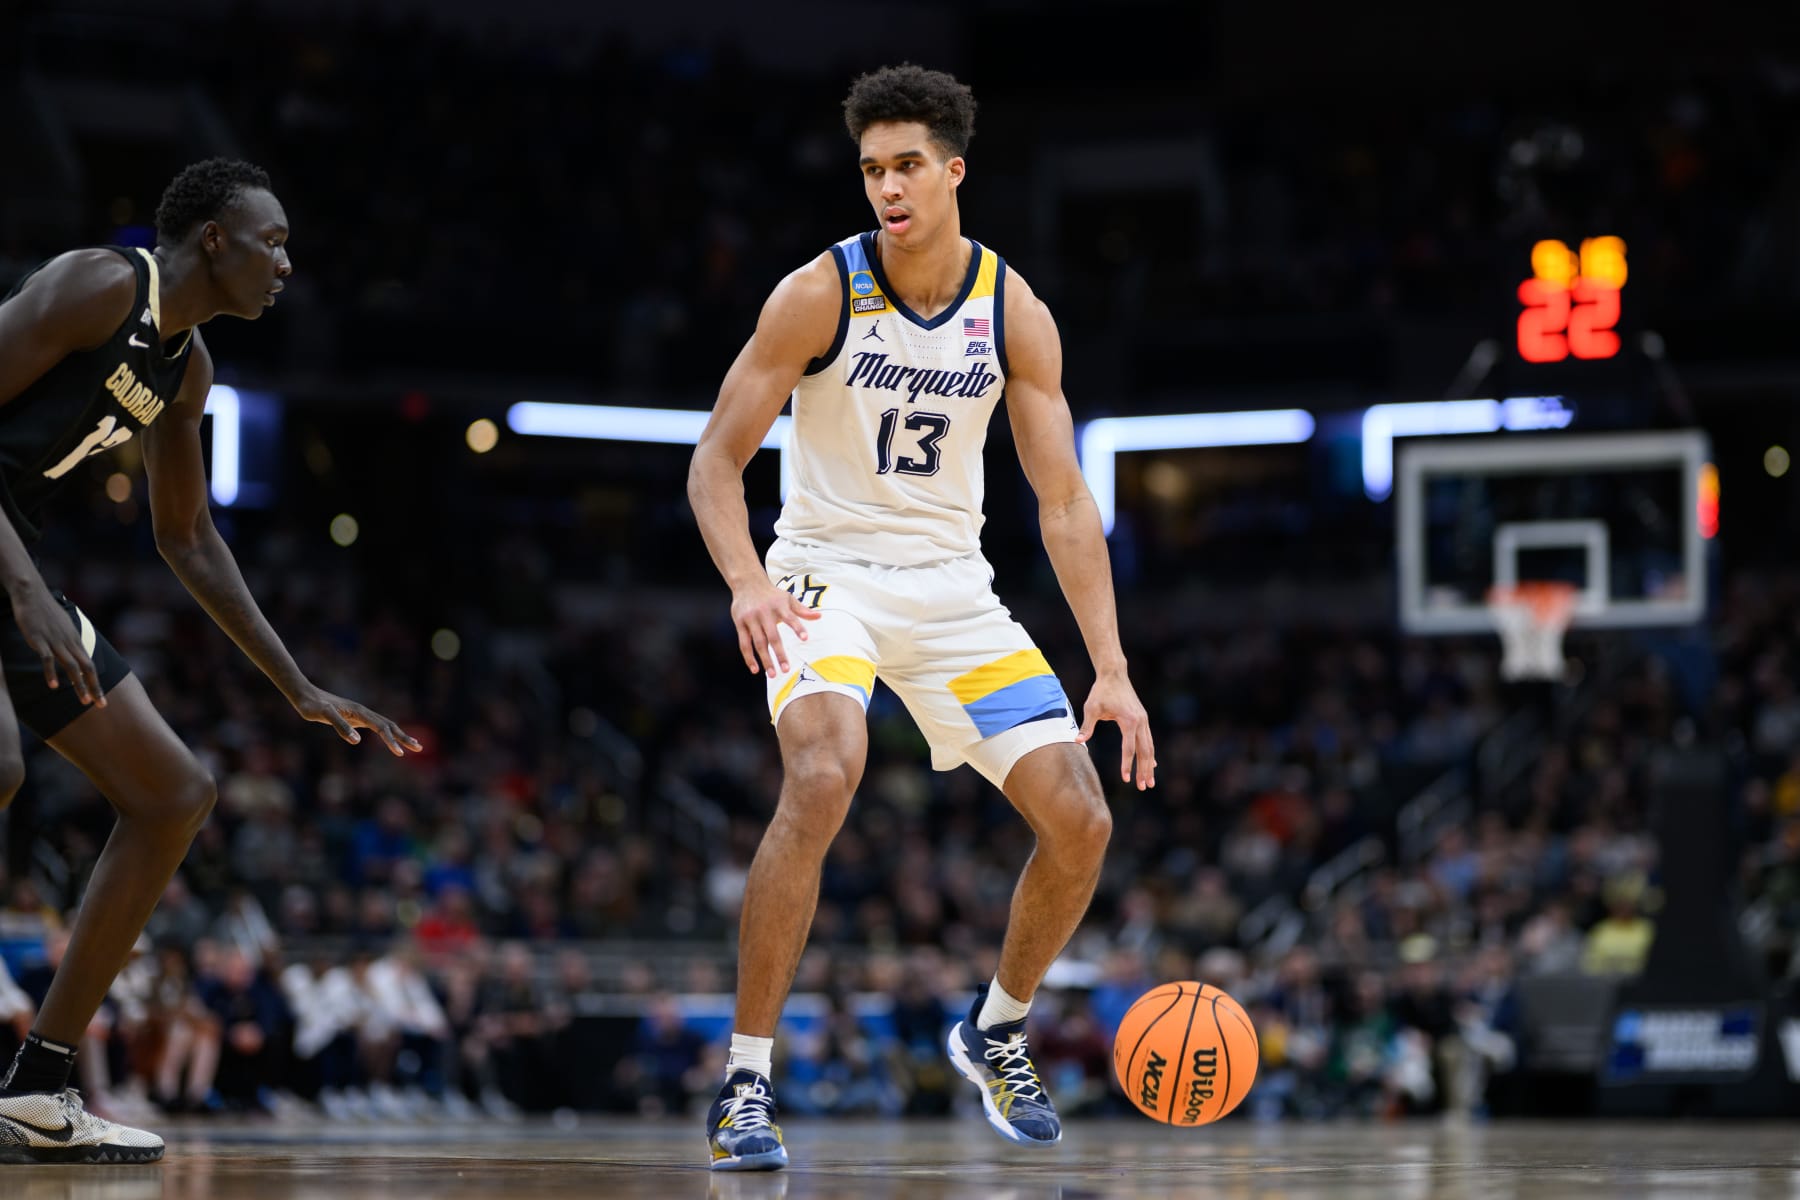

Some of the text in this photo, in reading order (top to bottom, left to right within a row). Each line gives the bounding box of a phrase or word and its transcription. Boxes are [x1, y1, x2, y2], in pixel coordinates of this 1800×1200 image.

[855, 303, 885, 312] CHANGE
[1517, 276, 1622, 363] 22
[846, 351, 998, 403] Marquette
[876, 408, 950, 477] 13
[1141, 1050, 1167, 1112] NCAA
[1181, 1047, 1217, 1124] Wilson
